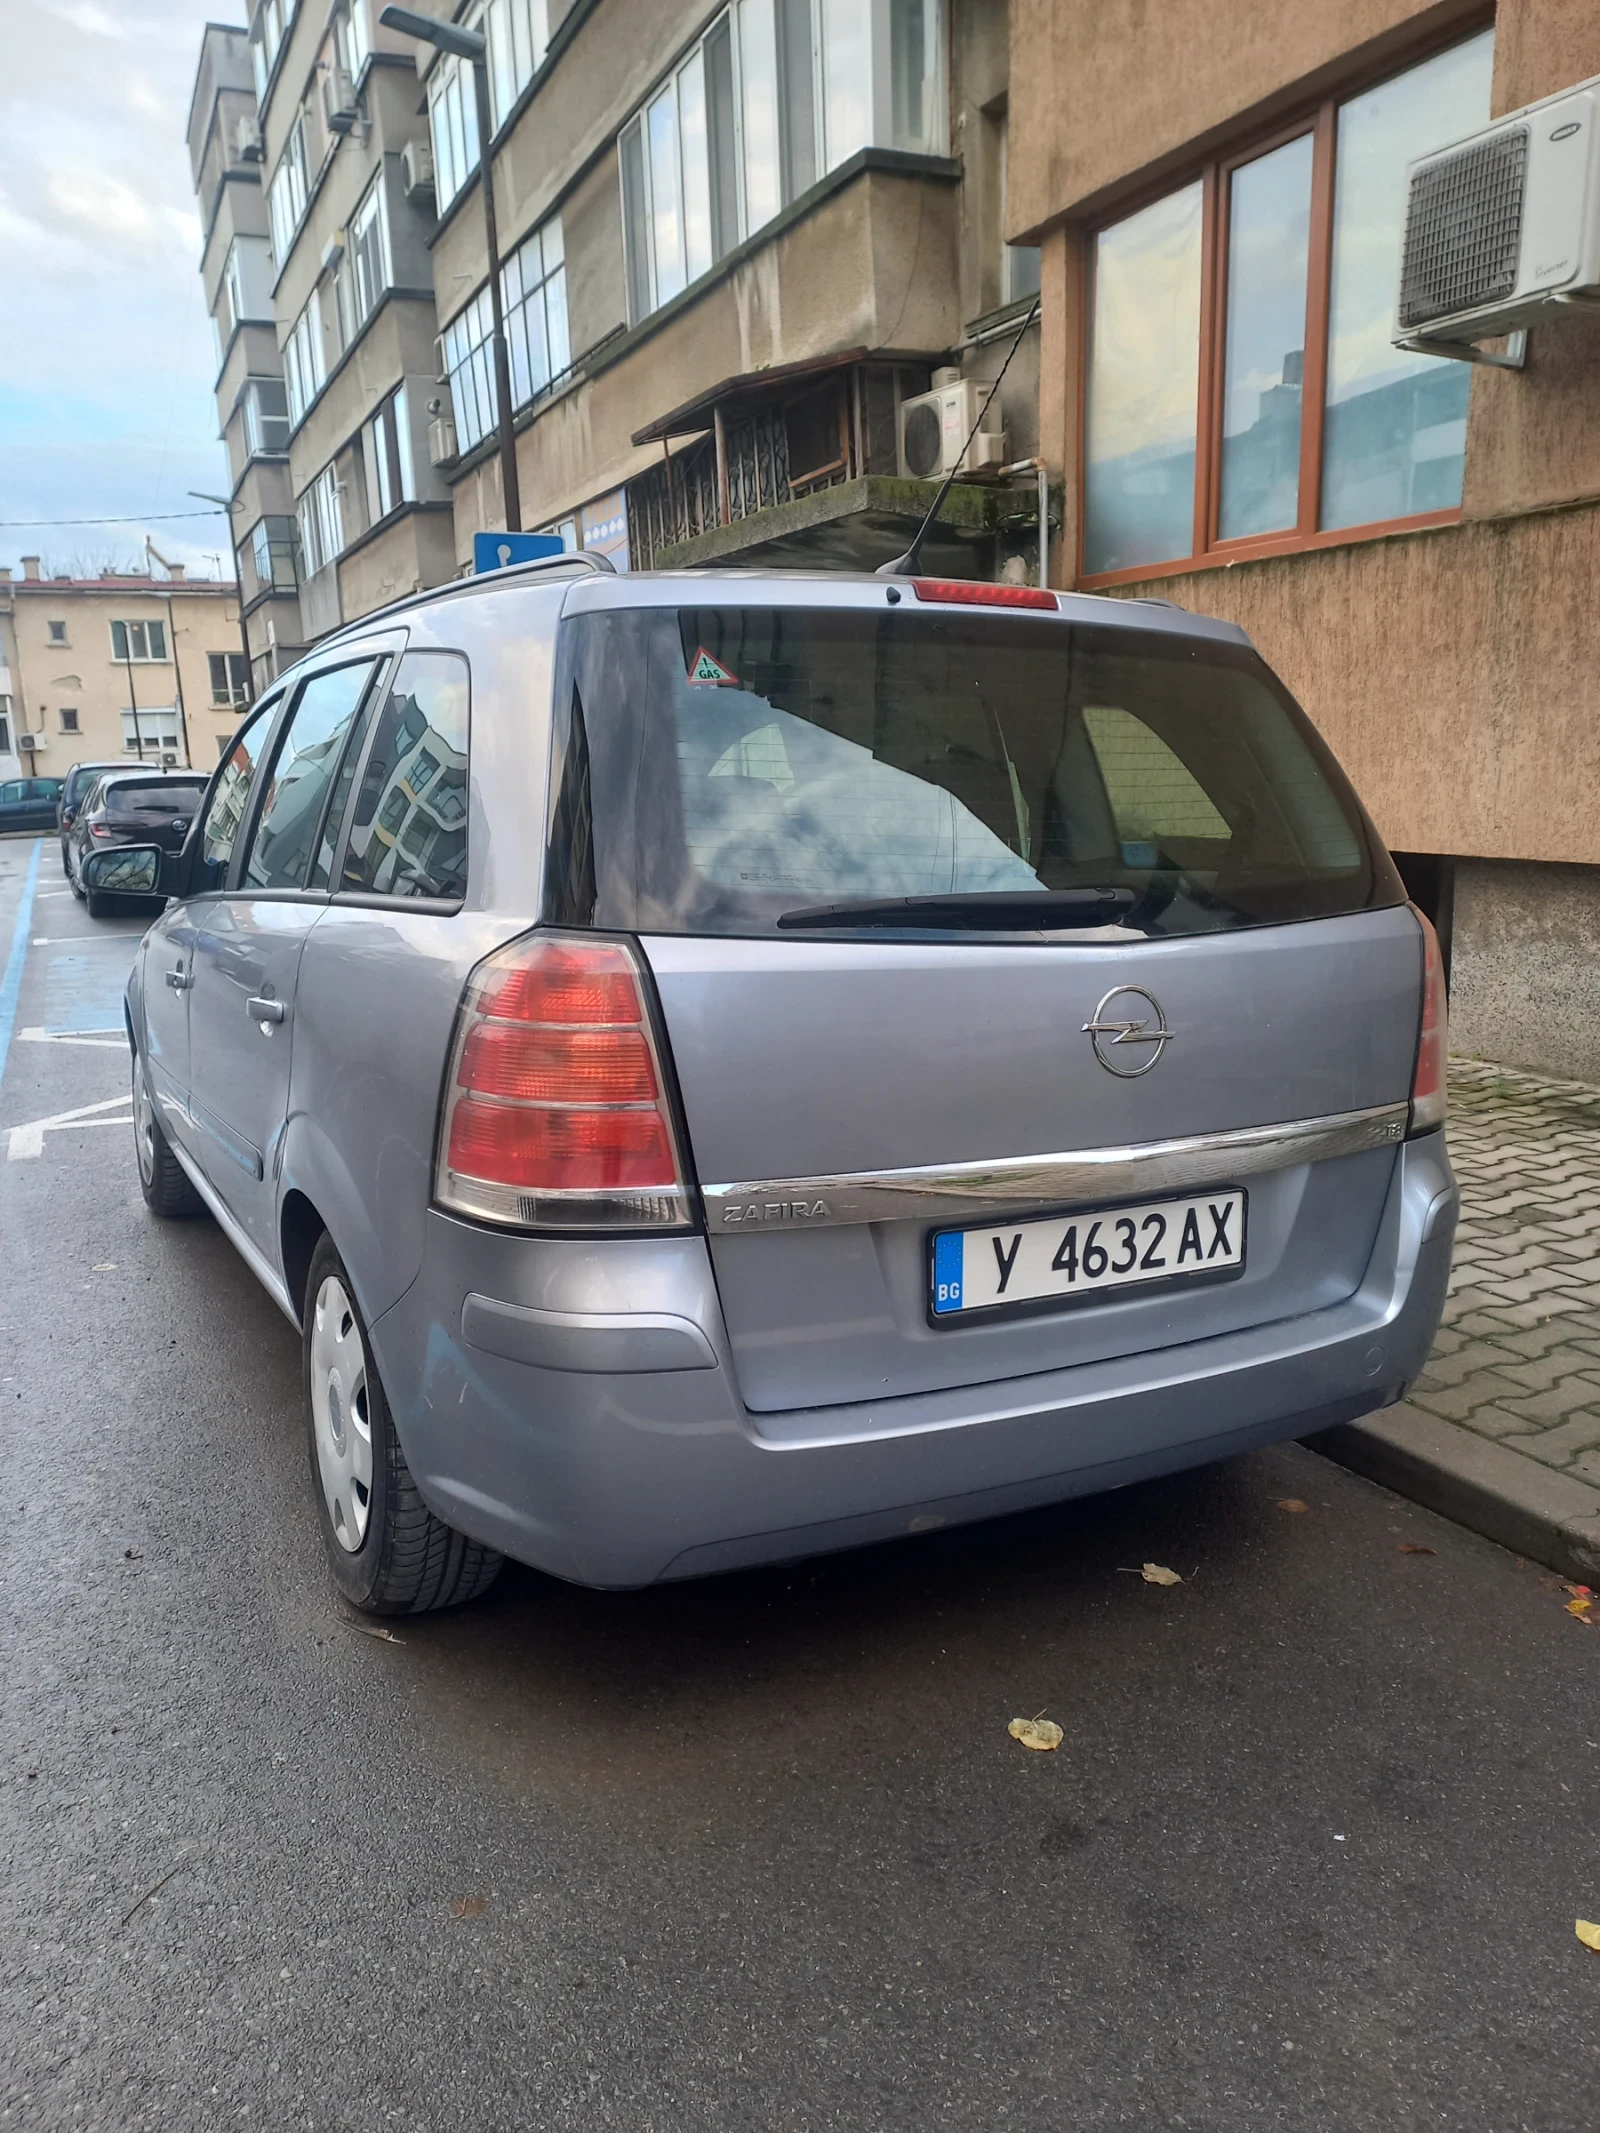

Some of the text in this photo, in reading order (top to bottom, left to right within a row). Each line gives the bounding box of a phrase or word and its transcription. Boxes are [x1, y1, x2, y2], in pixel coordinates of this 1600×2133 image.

[698, 669, 720, 680] GAS
[722, 1200, 831, 1223] ZAFIRA
[992, 1201, 1235, 1295] Y 4632 AX
[937, 1282, 961, 1303] BG
